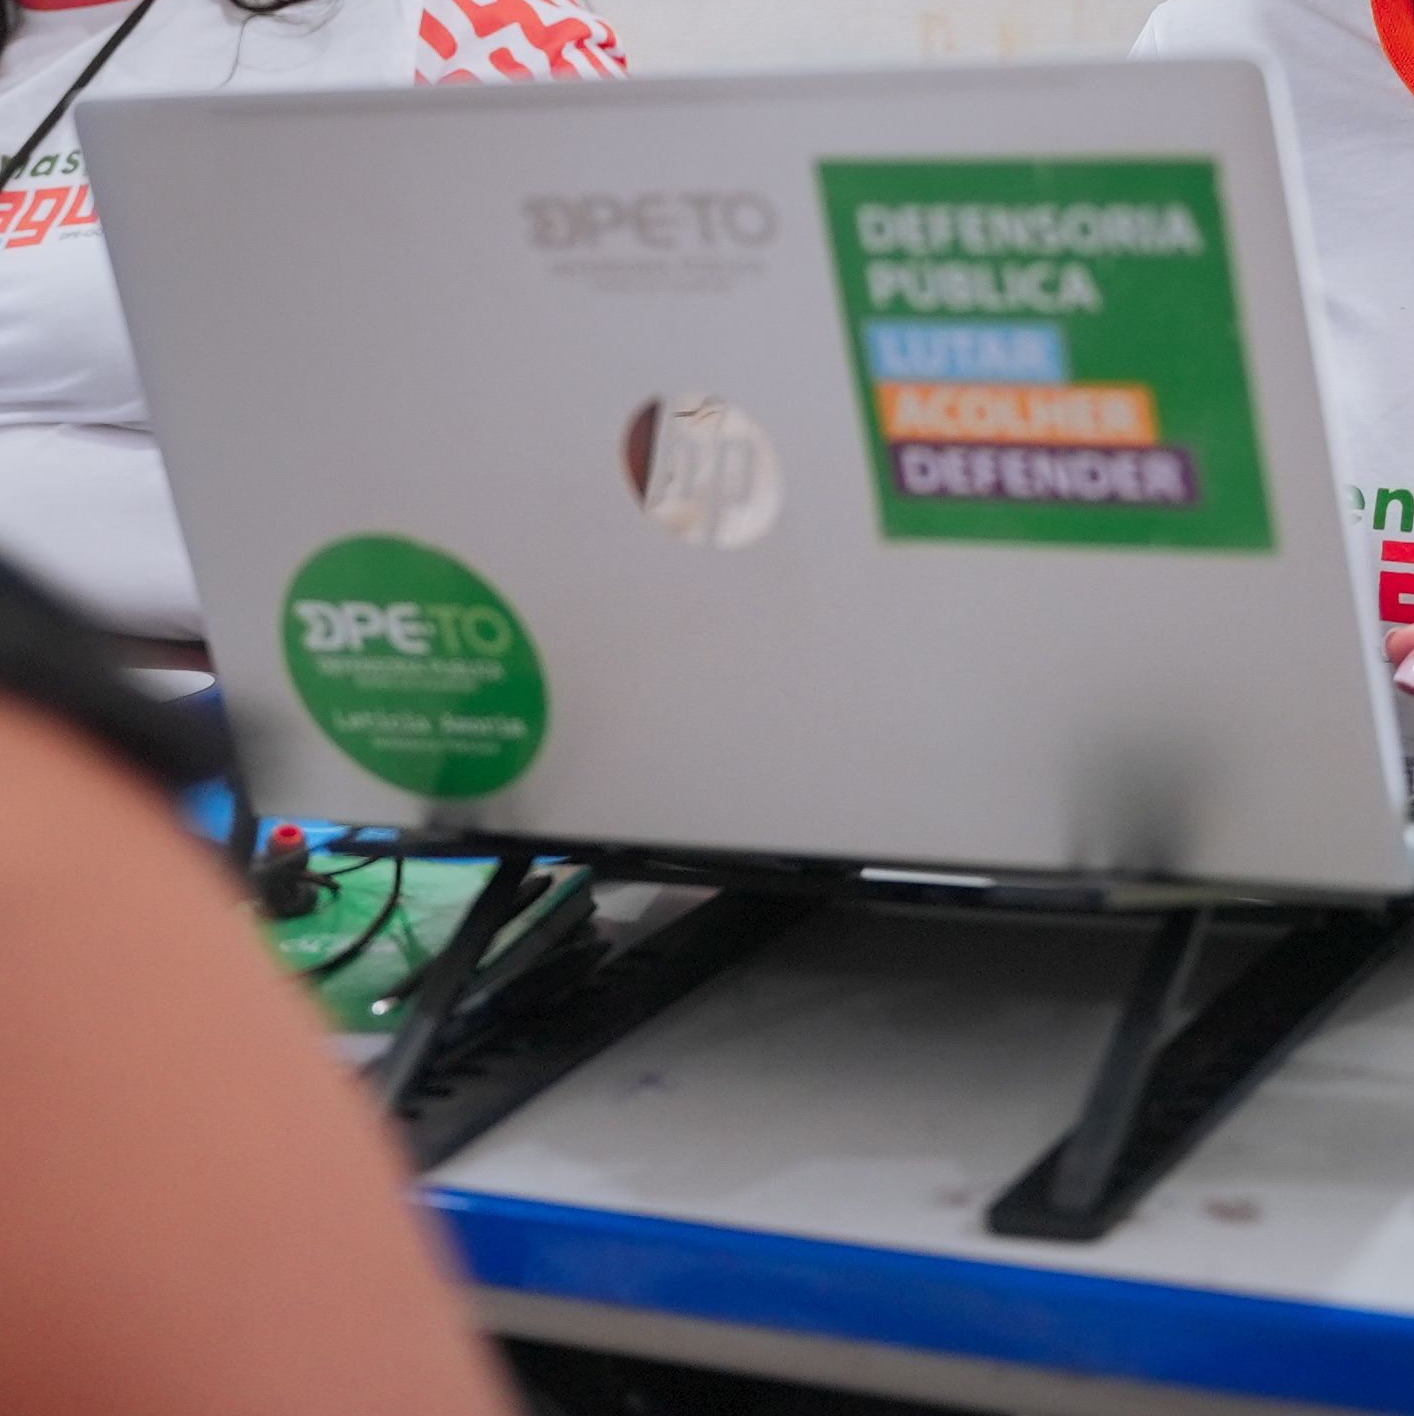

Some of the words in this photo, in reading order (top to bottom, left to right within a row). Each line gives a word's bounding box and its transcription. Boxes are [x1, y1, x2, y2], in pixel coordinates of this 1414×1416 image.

[856, 202, 1203, 257] DEFENSORIA
[883, 331, 1051, 377] LUTAR
[893, 387, 1135, 440] ACOLHER
[900, 449, 1184, 502] DEFENDER
[292, 599, 514, 658] DPETO
